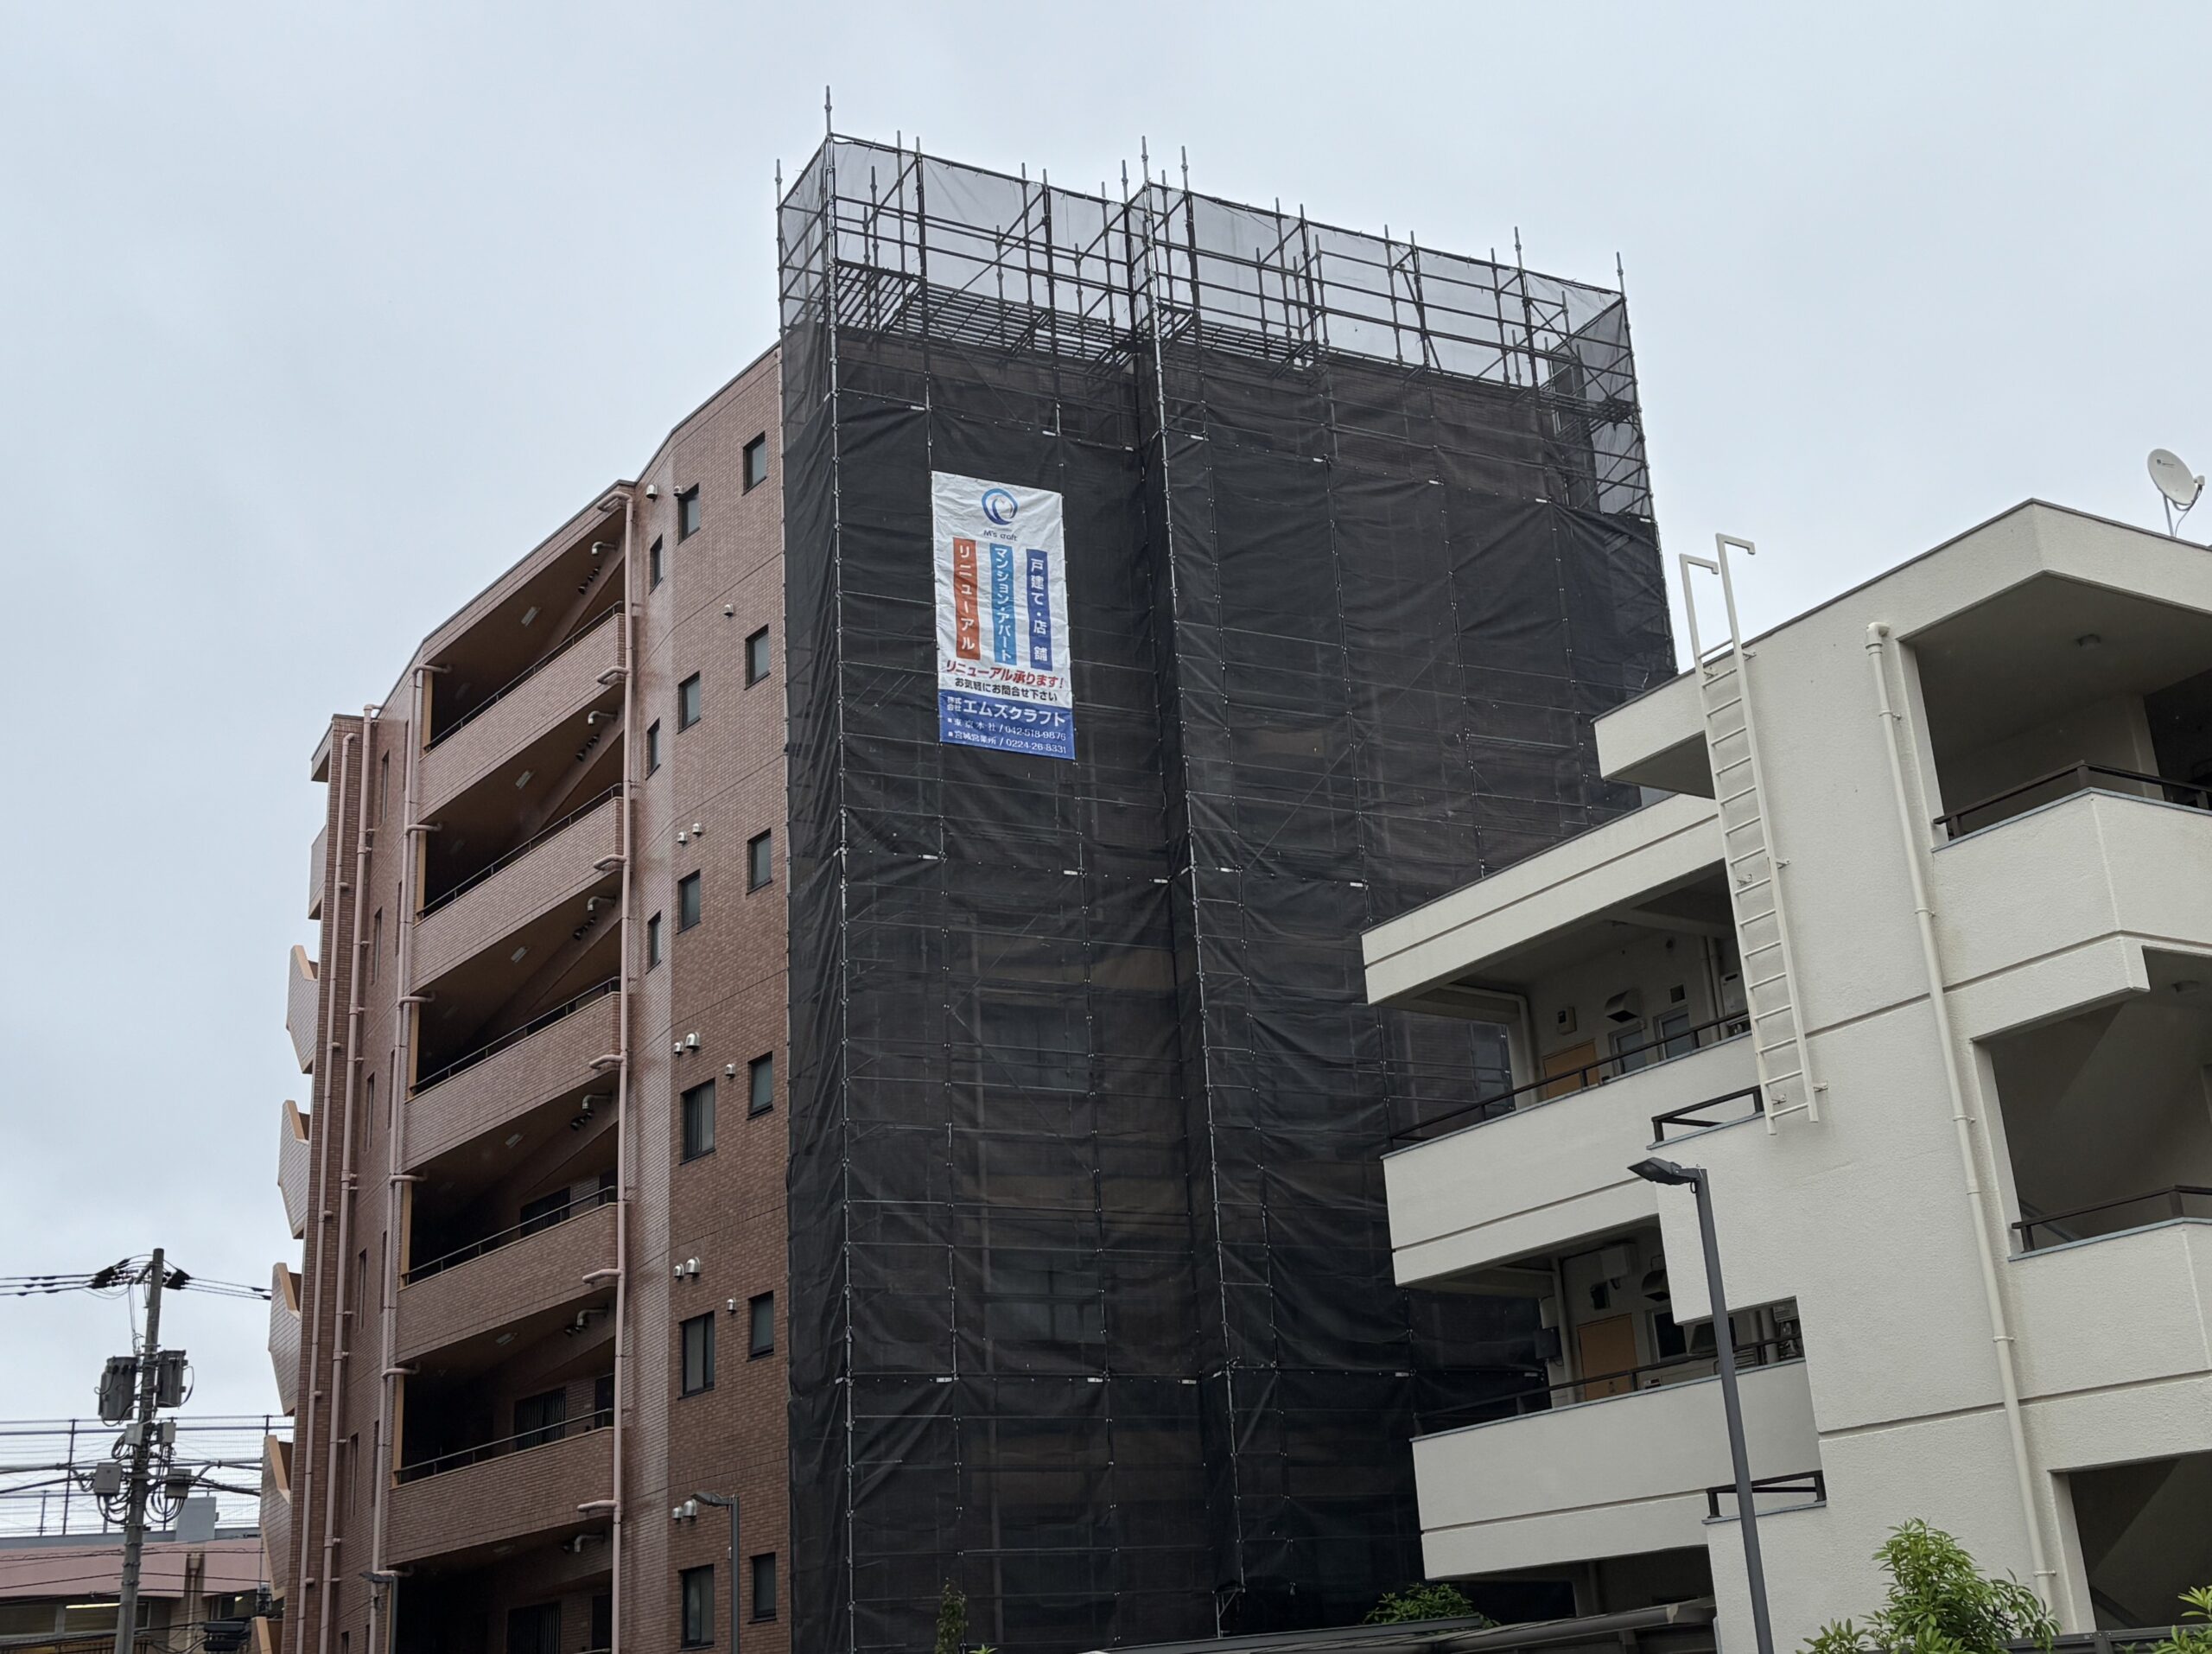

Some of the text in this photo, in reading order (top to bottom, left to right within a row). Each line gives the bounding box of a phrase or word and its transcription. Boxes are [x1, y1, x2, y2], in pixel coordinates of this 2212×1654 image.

[960, 544, 976, 650] リニューアル
[955, 678, 1058, 702] お気軽にお問合せ下さい
